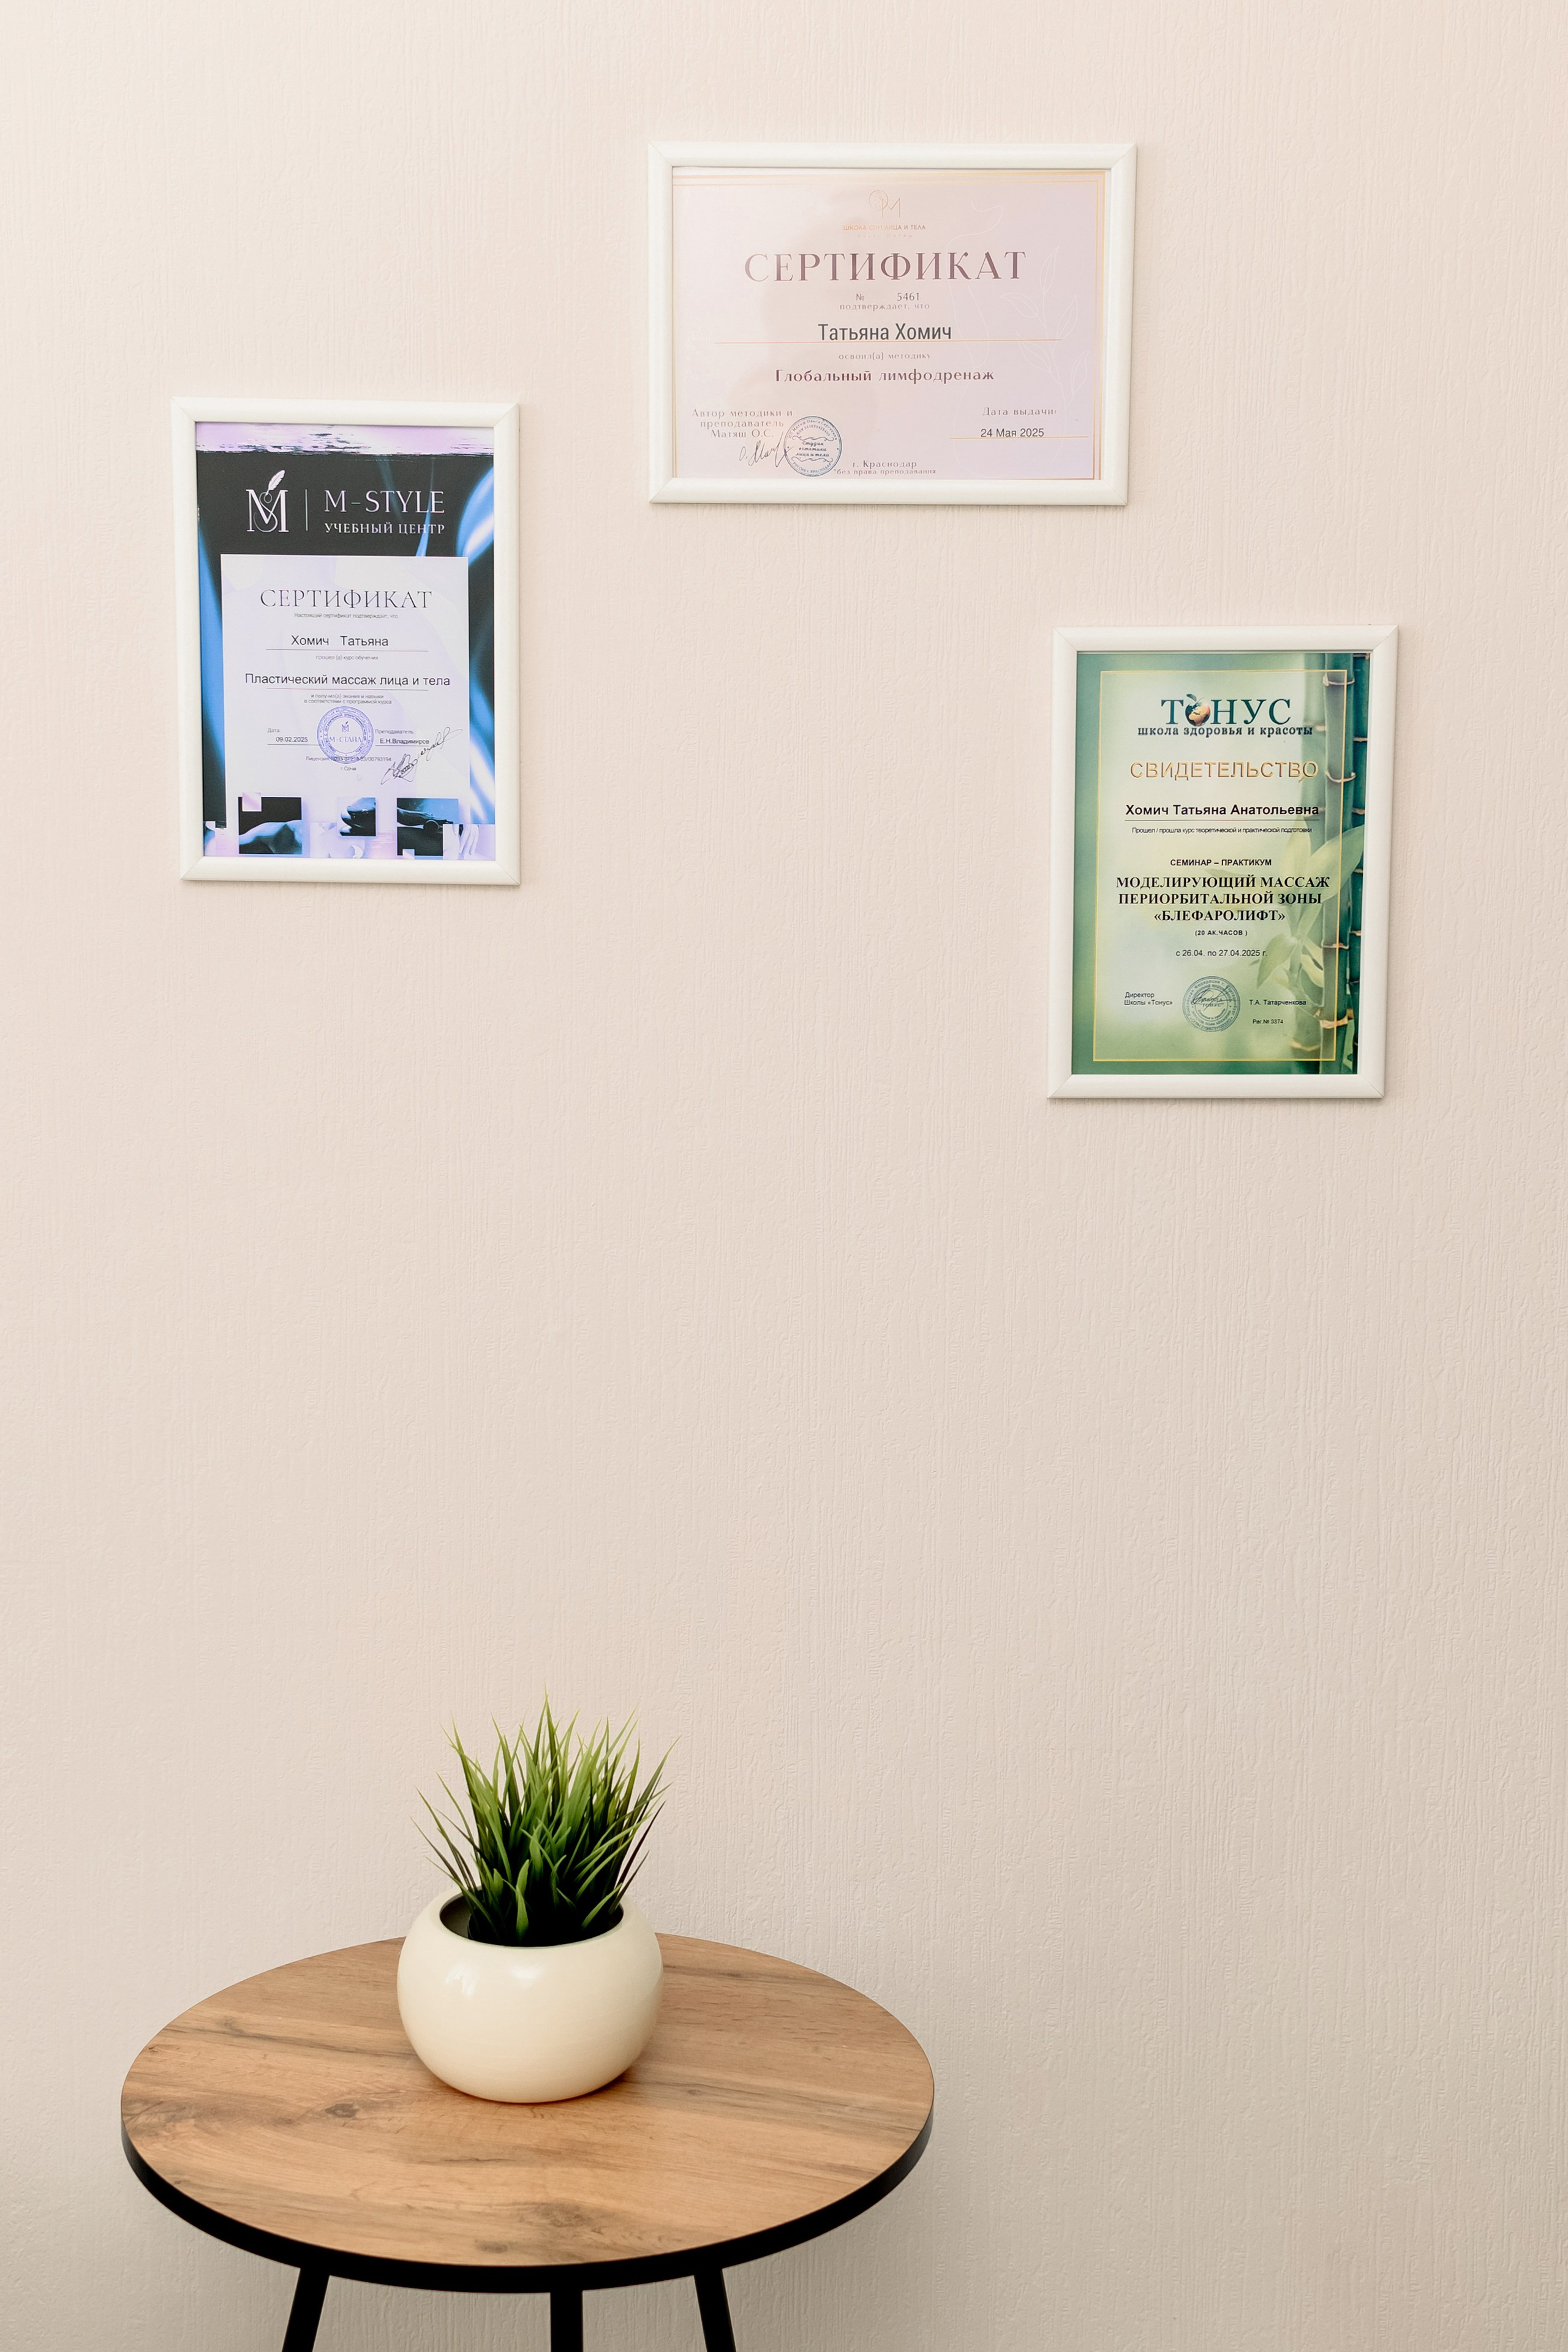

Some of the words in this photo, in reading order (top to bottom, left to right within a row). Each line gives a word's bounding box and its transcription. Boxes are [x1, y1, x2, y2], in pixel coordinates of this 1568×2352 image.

[745, 252, 1026, 282] СЕРТИФИКАТ
[897, 292, 920, 301] 5461
[818, 323, 889, 340] Татьяна
[895, 323, 952, 340] Хомич
[775, 369, 872, 382] Глобальный
[878, 369, 994, 384] лимфодренаж
[692, 409, 725, 419] Автор
[982, 407, 1008, 416] Дата
[711, 429, 746, 438] Матяш
[752, 429, 774, 438] О.С.
[981, 428, 993, 437] 24
[996, 428, 1016, 437] Мая
[1020, 428, 1044, 437] 2025
[863, 460, 917, 469] Краснодар
[324, 521, 393, 534] УЧЕБНЫЙ
[398, 524, 445, 534] ЦЕНТР
[260, 589, 432, 609] СЕРТИФИКАТ
[292, 635, 329, 645] Хомич
[340, 636, 388, 646] Татьяна
[245, 673, 328, 685] Пластический
[332, 676, 376, 685] массаж
[380, 676, 409, 687] лица
[412, 677, 419, 685] и
[423, 677, 450, 686] тела
[1137, 726, 1178, 736] школа
[1183, 726, 1242, 737] здоровья
[1248, 726, 1254, 735] и
[1261, 726, 1313, 737] красоты
[1130, 761, 1319, 781] СВИДЕТЕЛЬСТВО
[1126, 804, 1169, 815] Хомич
[1173, 804, 1226, 815] Татьяна
[1231, 804, 1319, 815] Анатольевна
[1116, 875, 1256, 889] МОДЕЛИРУЮЩИЙ
[1261, 876, 1330, 888] МАССАЖ
[1118, 891, 1273, 904] ПЕРИОРБИТАЛЬНОЙ
[1278, 893, 1322, 904] ЗОНЫ
[1155, 910, 1286, 921] «БЛЕФАРОЛИФТ»
